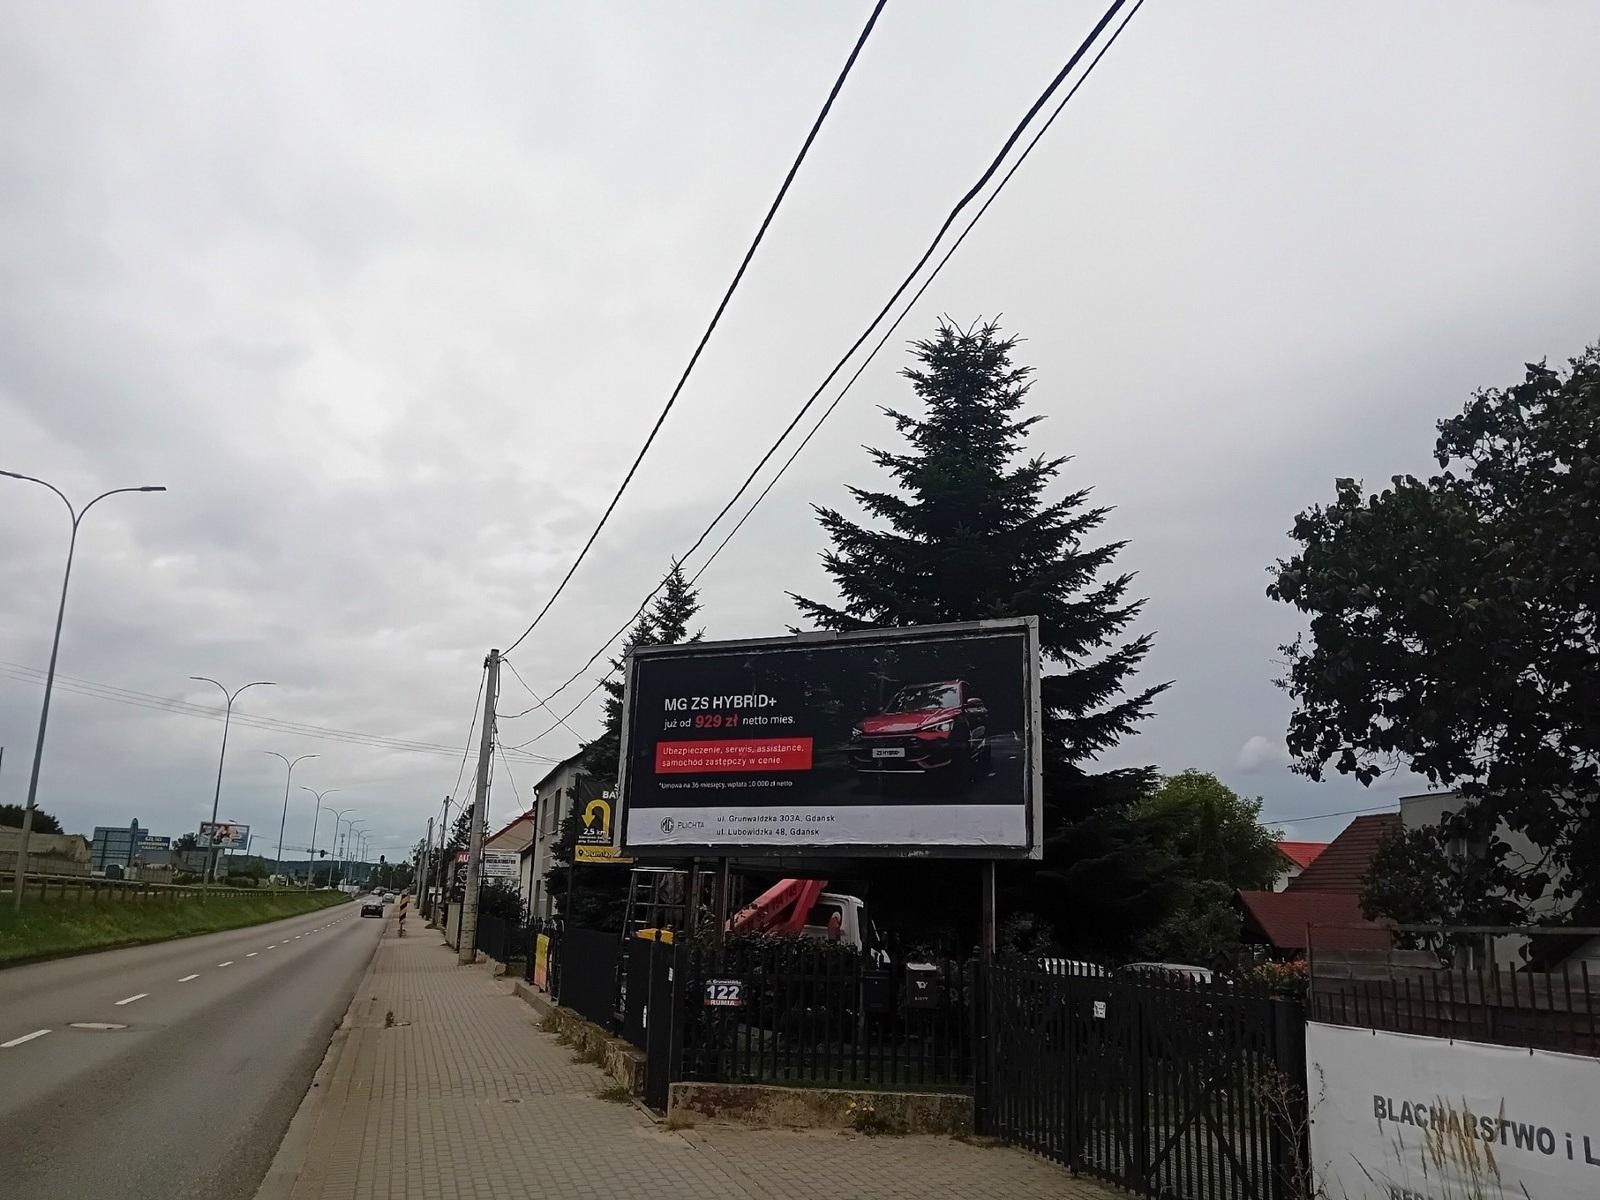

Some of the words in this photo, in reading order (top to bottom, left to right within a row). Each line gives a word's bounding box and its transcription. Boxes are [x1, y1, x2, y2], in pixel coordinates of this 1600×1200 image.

[664, 698, 688, 711] MG
[691, 697, 709, 710] ZS
[712, 694, 777, 709] HYBRID+
[663, 718, 677, 730] już
[679, 718, 692, 727] od
[695, 715, 722, 728] 929
[725, 714, 739, 727] zł
[742, 716, 768, 725] netto
[770, 715, 796, 724] mies.
[663, 746, 723, 756] Ubezpieczenie,
[725, 744, 755, 754] serwis,
[758, 756, 783, 765] cenie.
[779, 814, 802, 823] 303A,
[728, 828, 773, 836] Lubowidzka
[706, 985, 740, 1000] 122
[1565, 1132, 1574, 1160] i
